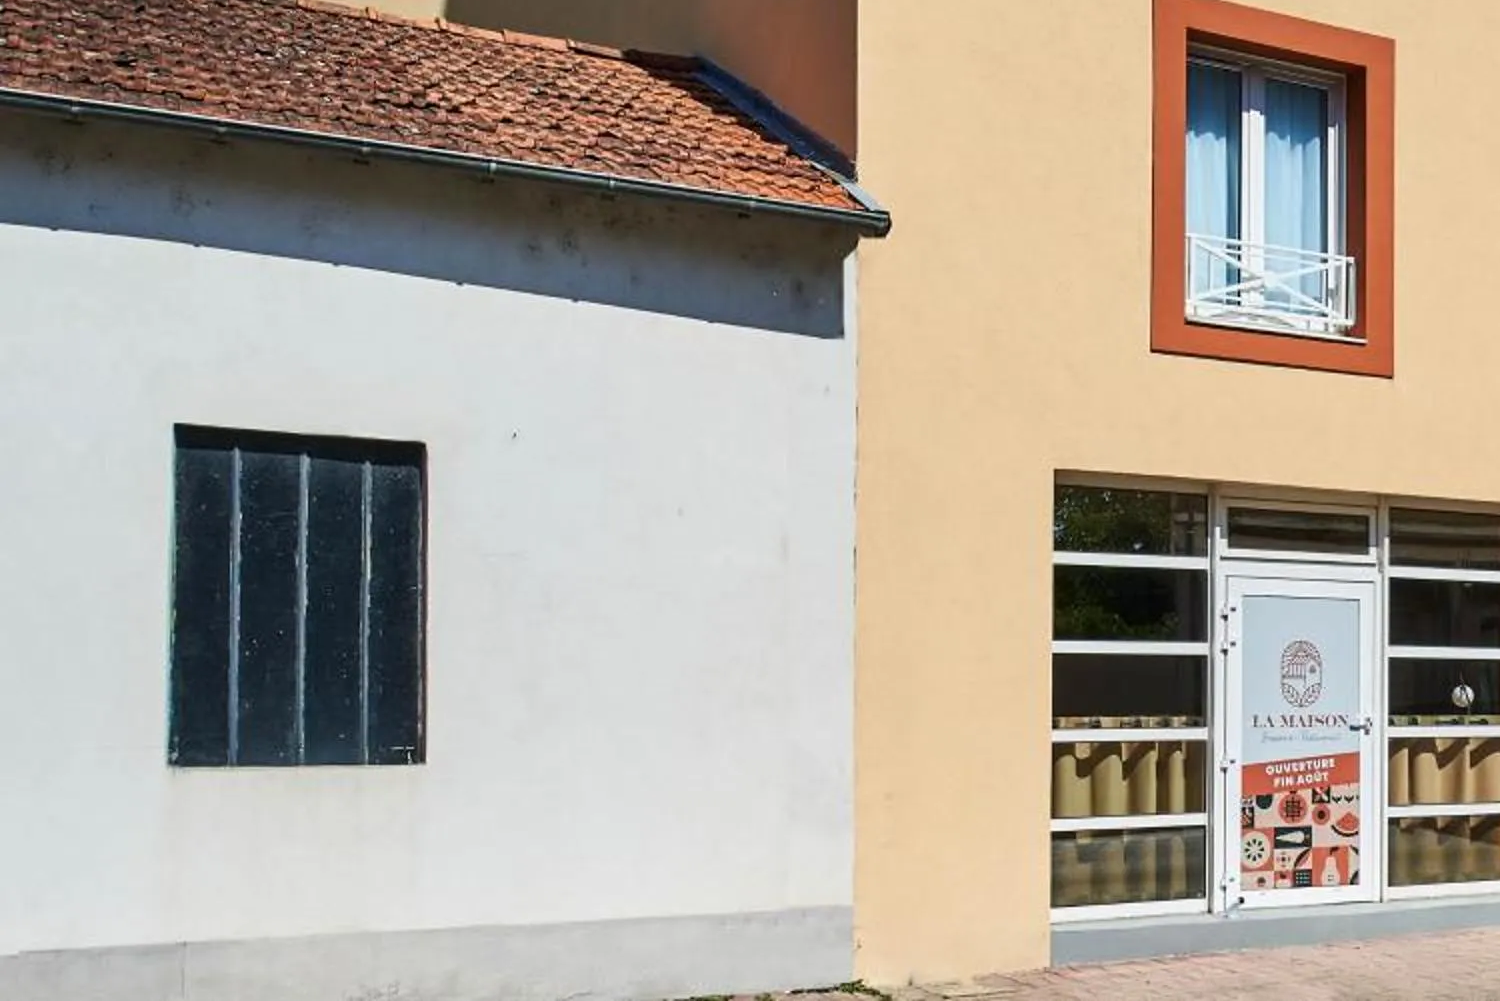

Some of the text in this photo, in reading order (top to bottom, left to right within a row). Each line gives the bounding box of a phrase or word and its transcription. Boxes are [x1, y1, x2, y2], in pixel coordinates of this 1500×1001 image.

[1252, 714, 1349, 728] LA MAISON
[1265, 758, 1336, 776] OUVERTURE
[1273, 770, 1329, 788] FIN AOÛT
